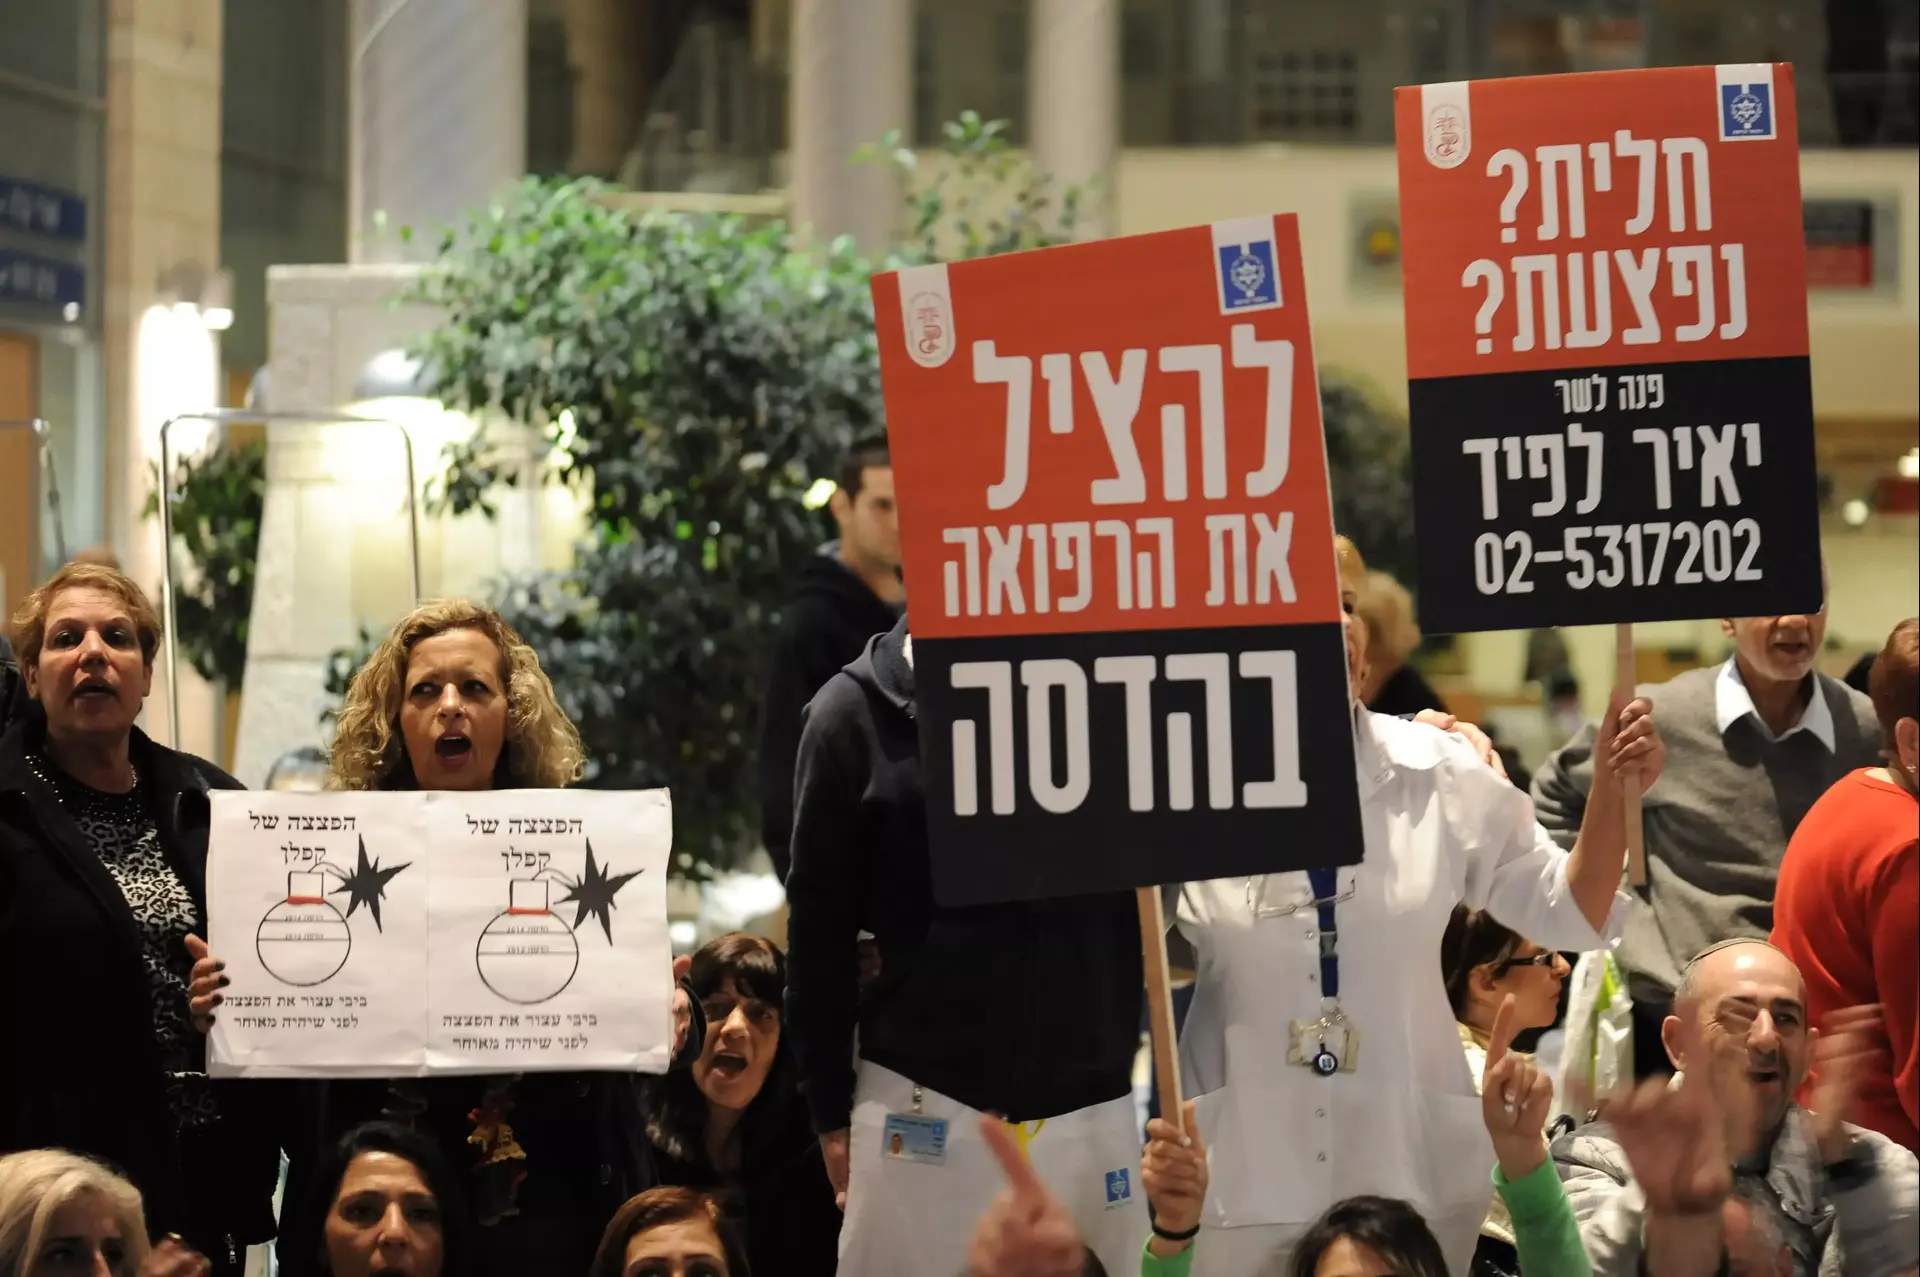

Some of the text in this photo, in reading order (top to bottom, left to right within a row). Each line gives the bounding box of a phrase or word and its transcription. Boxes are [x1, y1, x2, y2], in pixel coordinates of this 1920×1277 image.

[1486, 129, 1712, 243] חלית?
[1461, 243, 1748, 355] נפצעת?
[1553, 373, 1665, 414] פנה לשר
[972, 323, 1294, 510] להציל
[1462, 422, 1762, 520] יאיר לפיד
[942, 511, 1297, 617] את הרפואה
[1474, 518, 1763, 595] 02-5317202
[950, 649, 1308, 816] בהדסה
[248, 810, 356, 831] הפצצה של
[465, 813, 583, 835] הפצצה של
[280, 841, 327, 866] קפלן
[500, 845, 551, 872] קפלן
[224, 995, 368, 1008] ביבי עצור את הפצצה
[233, 1013, 359, 1029] לפני שיהיה מאוחר
[442, 1013, 598, 1028] ביבי עצור את הפצצה
[452, 1032, 589, 1051] לפני שיהיה מאוחר
